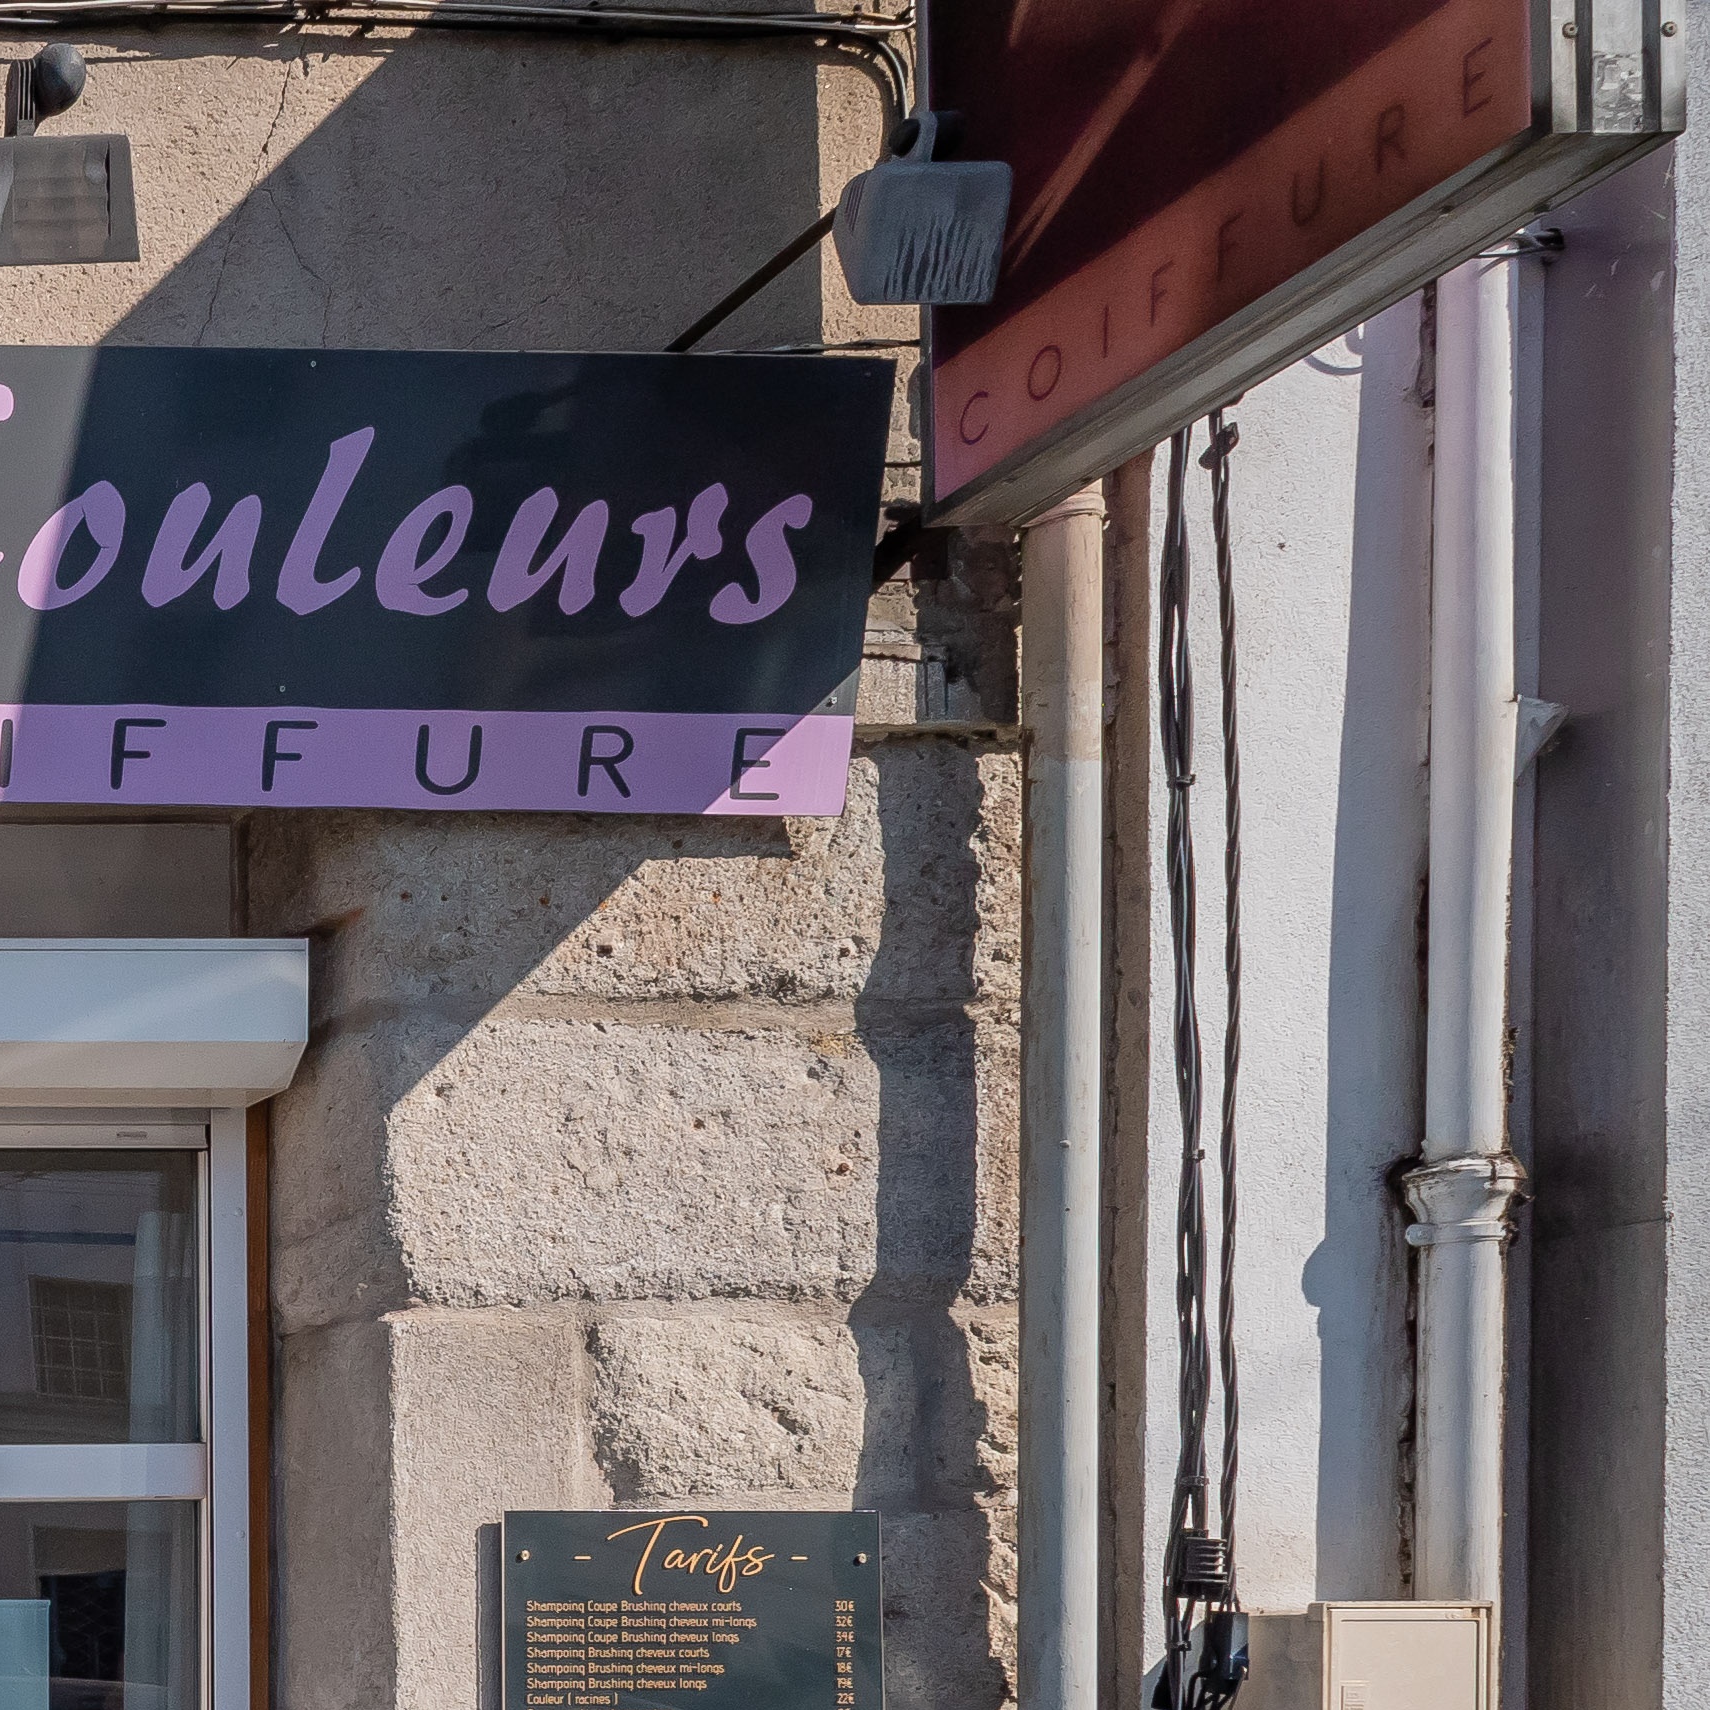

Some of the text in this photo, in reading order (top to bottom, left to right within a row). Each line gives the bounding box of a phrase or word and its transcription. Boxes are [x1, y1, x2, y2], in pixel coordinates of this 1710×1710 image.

[958, 36, 1494, 446] COIFFURE
[606, 1516, 775, 1595] Tarifs
[527, 1601, 855, 1614] Shampoing Coupe Brushing cheveux courts 30€
[527, 1616, 853, 1629] Shampoing Coupe Brushing cheveux mi-longs 32€
[527, 1632, 585, 1645] Shampoing
[588, 1632, 618, 1645] Coupe
[622, 1632, 667, 1645] Brushing
[670, 1632, 708, 1643] cheveux
[712, 1632, 739, 1645] longs
[527, 1646, 852, 1660] Shampoing Brushing cheveux courts 17€
[527, 1677, 853, 1690] Shampoing Brushing cheveux longs 19€
